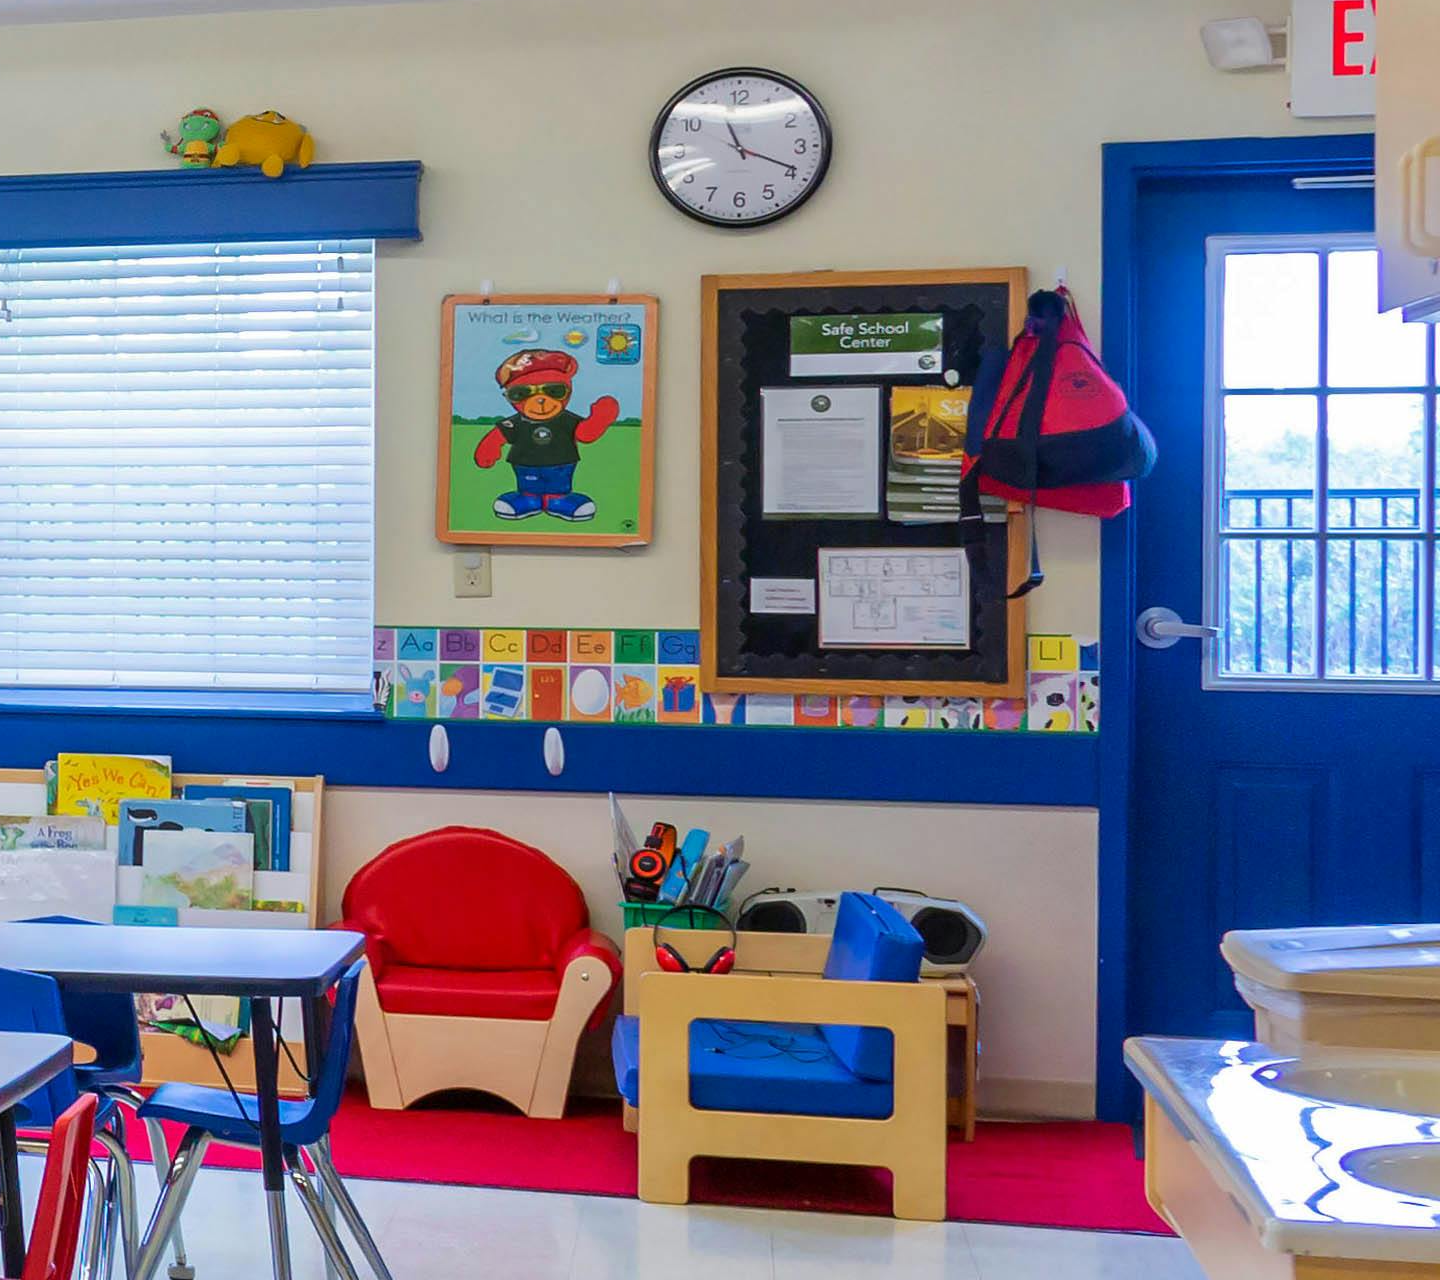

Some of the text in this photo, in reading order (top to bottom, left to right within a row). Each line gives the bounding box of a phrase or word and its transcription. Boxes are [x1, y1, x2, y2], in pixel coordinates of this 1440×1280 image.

[730, 90, 749, 105] 12
[682, 118, 701, 132] 10
[784, 113, 797, 128] 2
[794, 138, 806, 155] 3
[705, 186, 718, 202] 7
[762, 184, 775, 200] 5
[733, 192, 746, 208] 6
[468, 312, 631, 325] What is the Weather?
[822, 322, 909, 336] Safe School
[839, 336, 891, 349] Center
[400, 632, 696, 664] Aa Bb Cc Dd Ee Ff Gg
[71, 773, 100, 792] Yes
[103, 768, 124, 785] We
